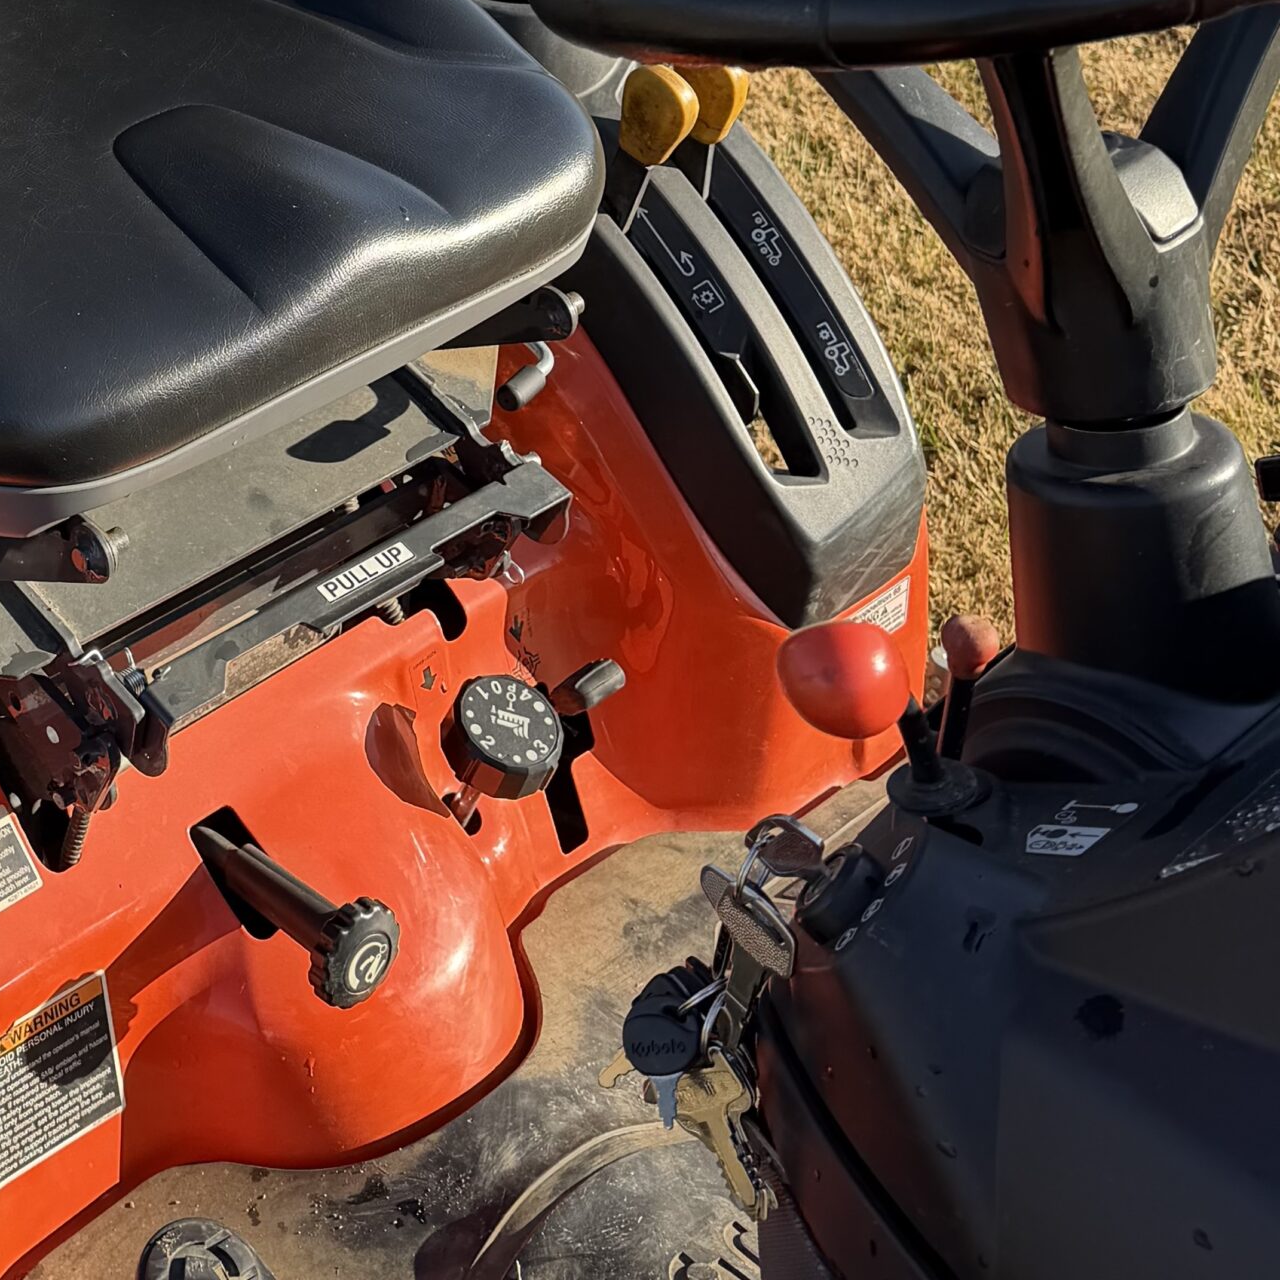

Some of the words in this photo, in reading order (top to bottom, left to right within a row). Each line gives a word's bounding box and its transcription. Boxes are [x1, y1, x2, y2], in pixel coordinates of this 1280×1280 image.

[323, 565, 379, 597] PULL
[374, 546, 402, 573] UP
[476, 686, 489, 700] 1
[490, 680, 502, 695] 0
[520, 688, 532, 701] 4
[480, 735, 496, 750] 2
[533, 739, 549, 754] 3
[8, 991, 80, 1046] WARNING
[15, 1020, 62, 1057] PERSONAL
[64, 1001, 94, 1026] INJURY
[631, 1038, 686, 1058] Kubota
